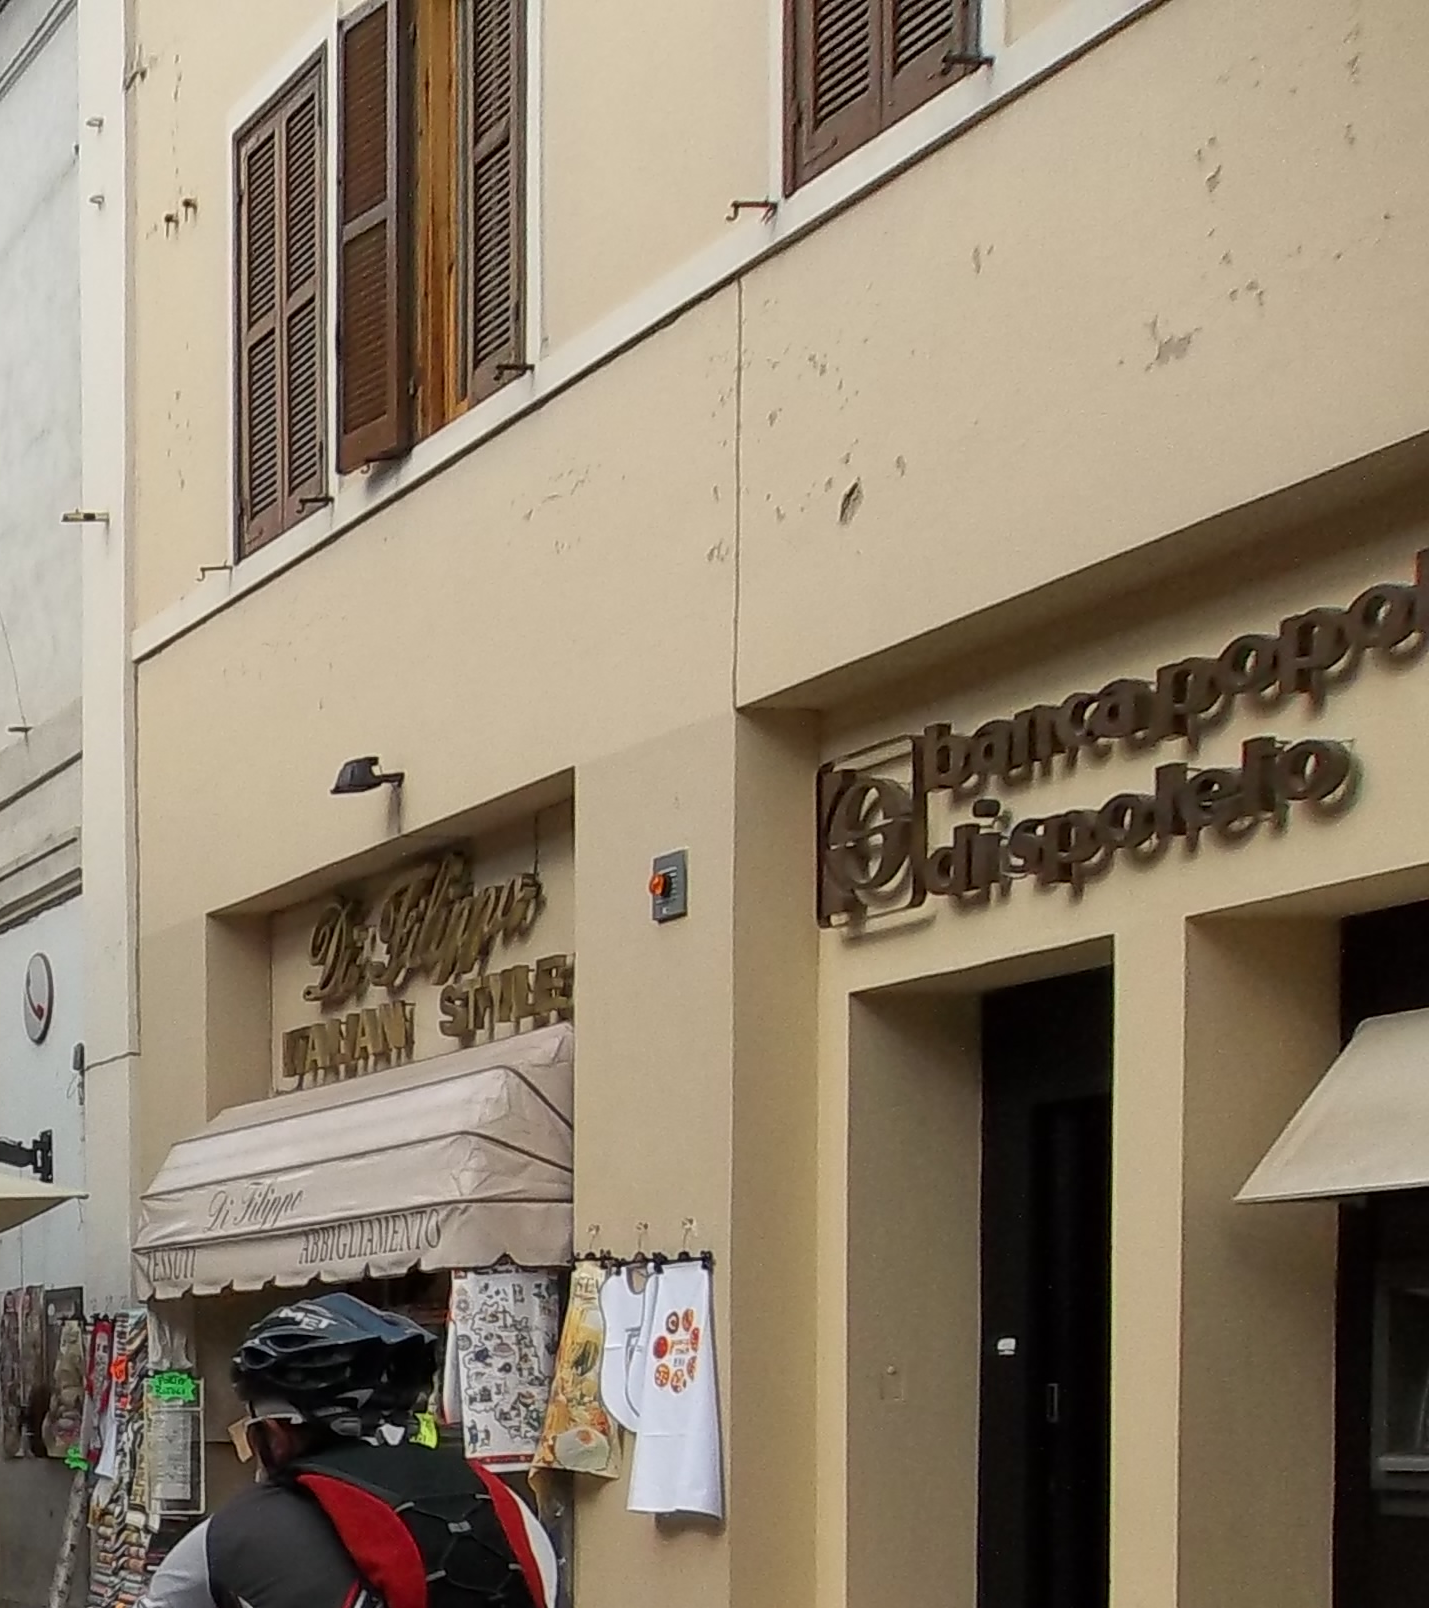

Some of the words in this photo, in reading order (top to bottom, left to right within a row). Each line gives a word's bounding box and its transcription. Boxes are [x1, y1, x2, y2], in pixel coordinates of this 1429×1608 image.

[283, 1000, 415, 1077] ITALIAN
[439, 953, 574, 1037] STYLE
[233, 1180, 304, 1230] Filippo
[297, 1208, 442, 1265] ABBIGLIAMENTO
[279, 1307, 338, 1331] MET
